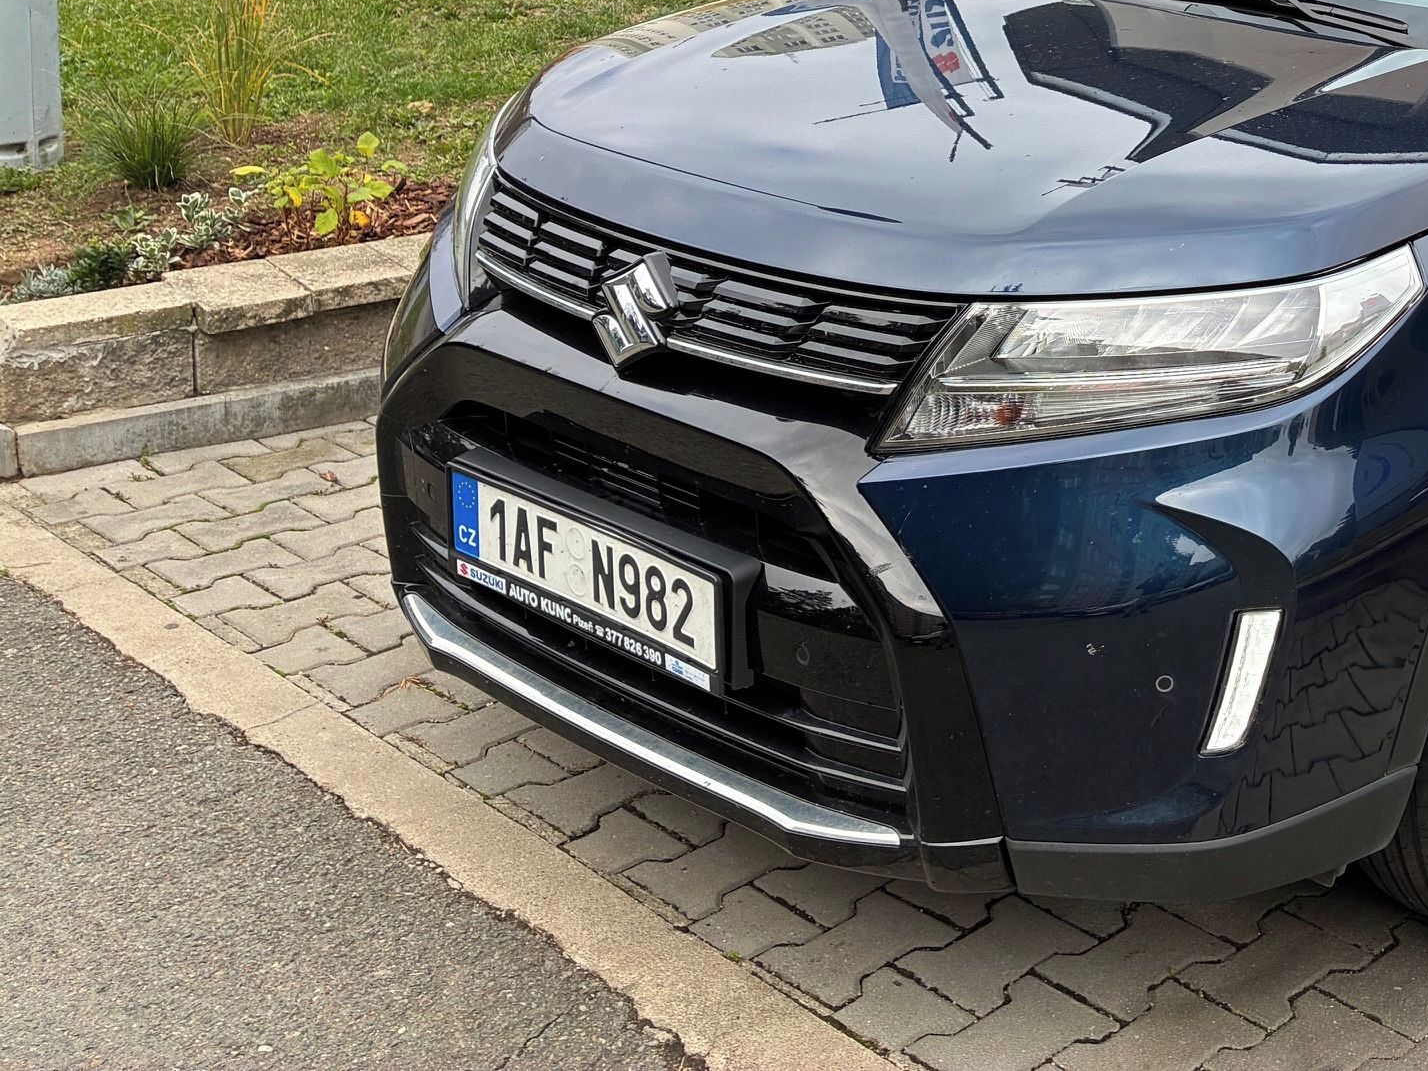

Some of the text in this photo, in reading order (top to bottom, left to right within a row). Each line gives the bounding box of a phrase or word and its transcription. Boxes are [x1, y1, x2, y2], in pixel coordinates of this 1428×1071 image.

[458, 524, 477, 547] CZ
[489, 498, 695, 649] 1AF N982
[469, 567, 662, 666] SUZUKI AUTO KUNC Plzeň 377 826 390
